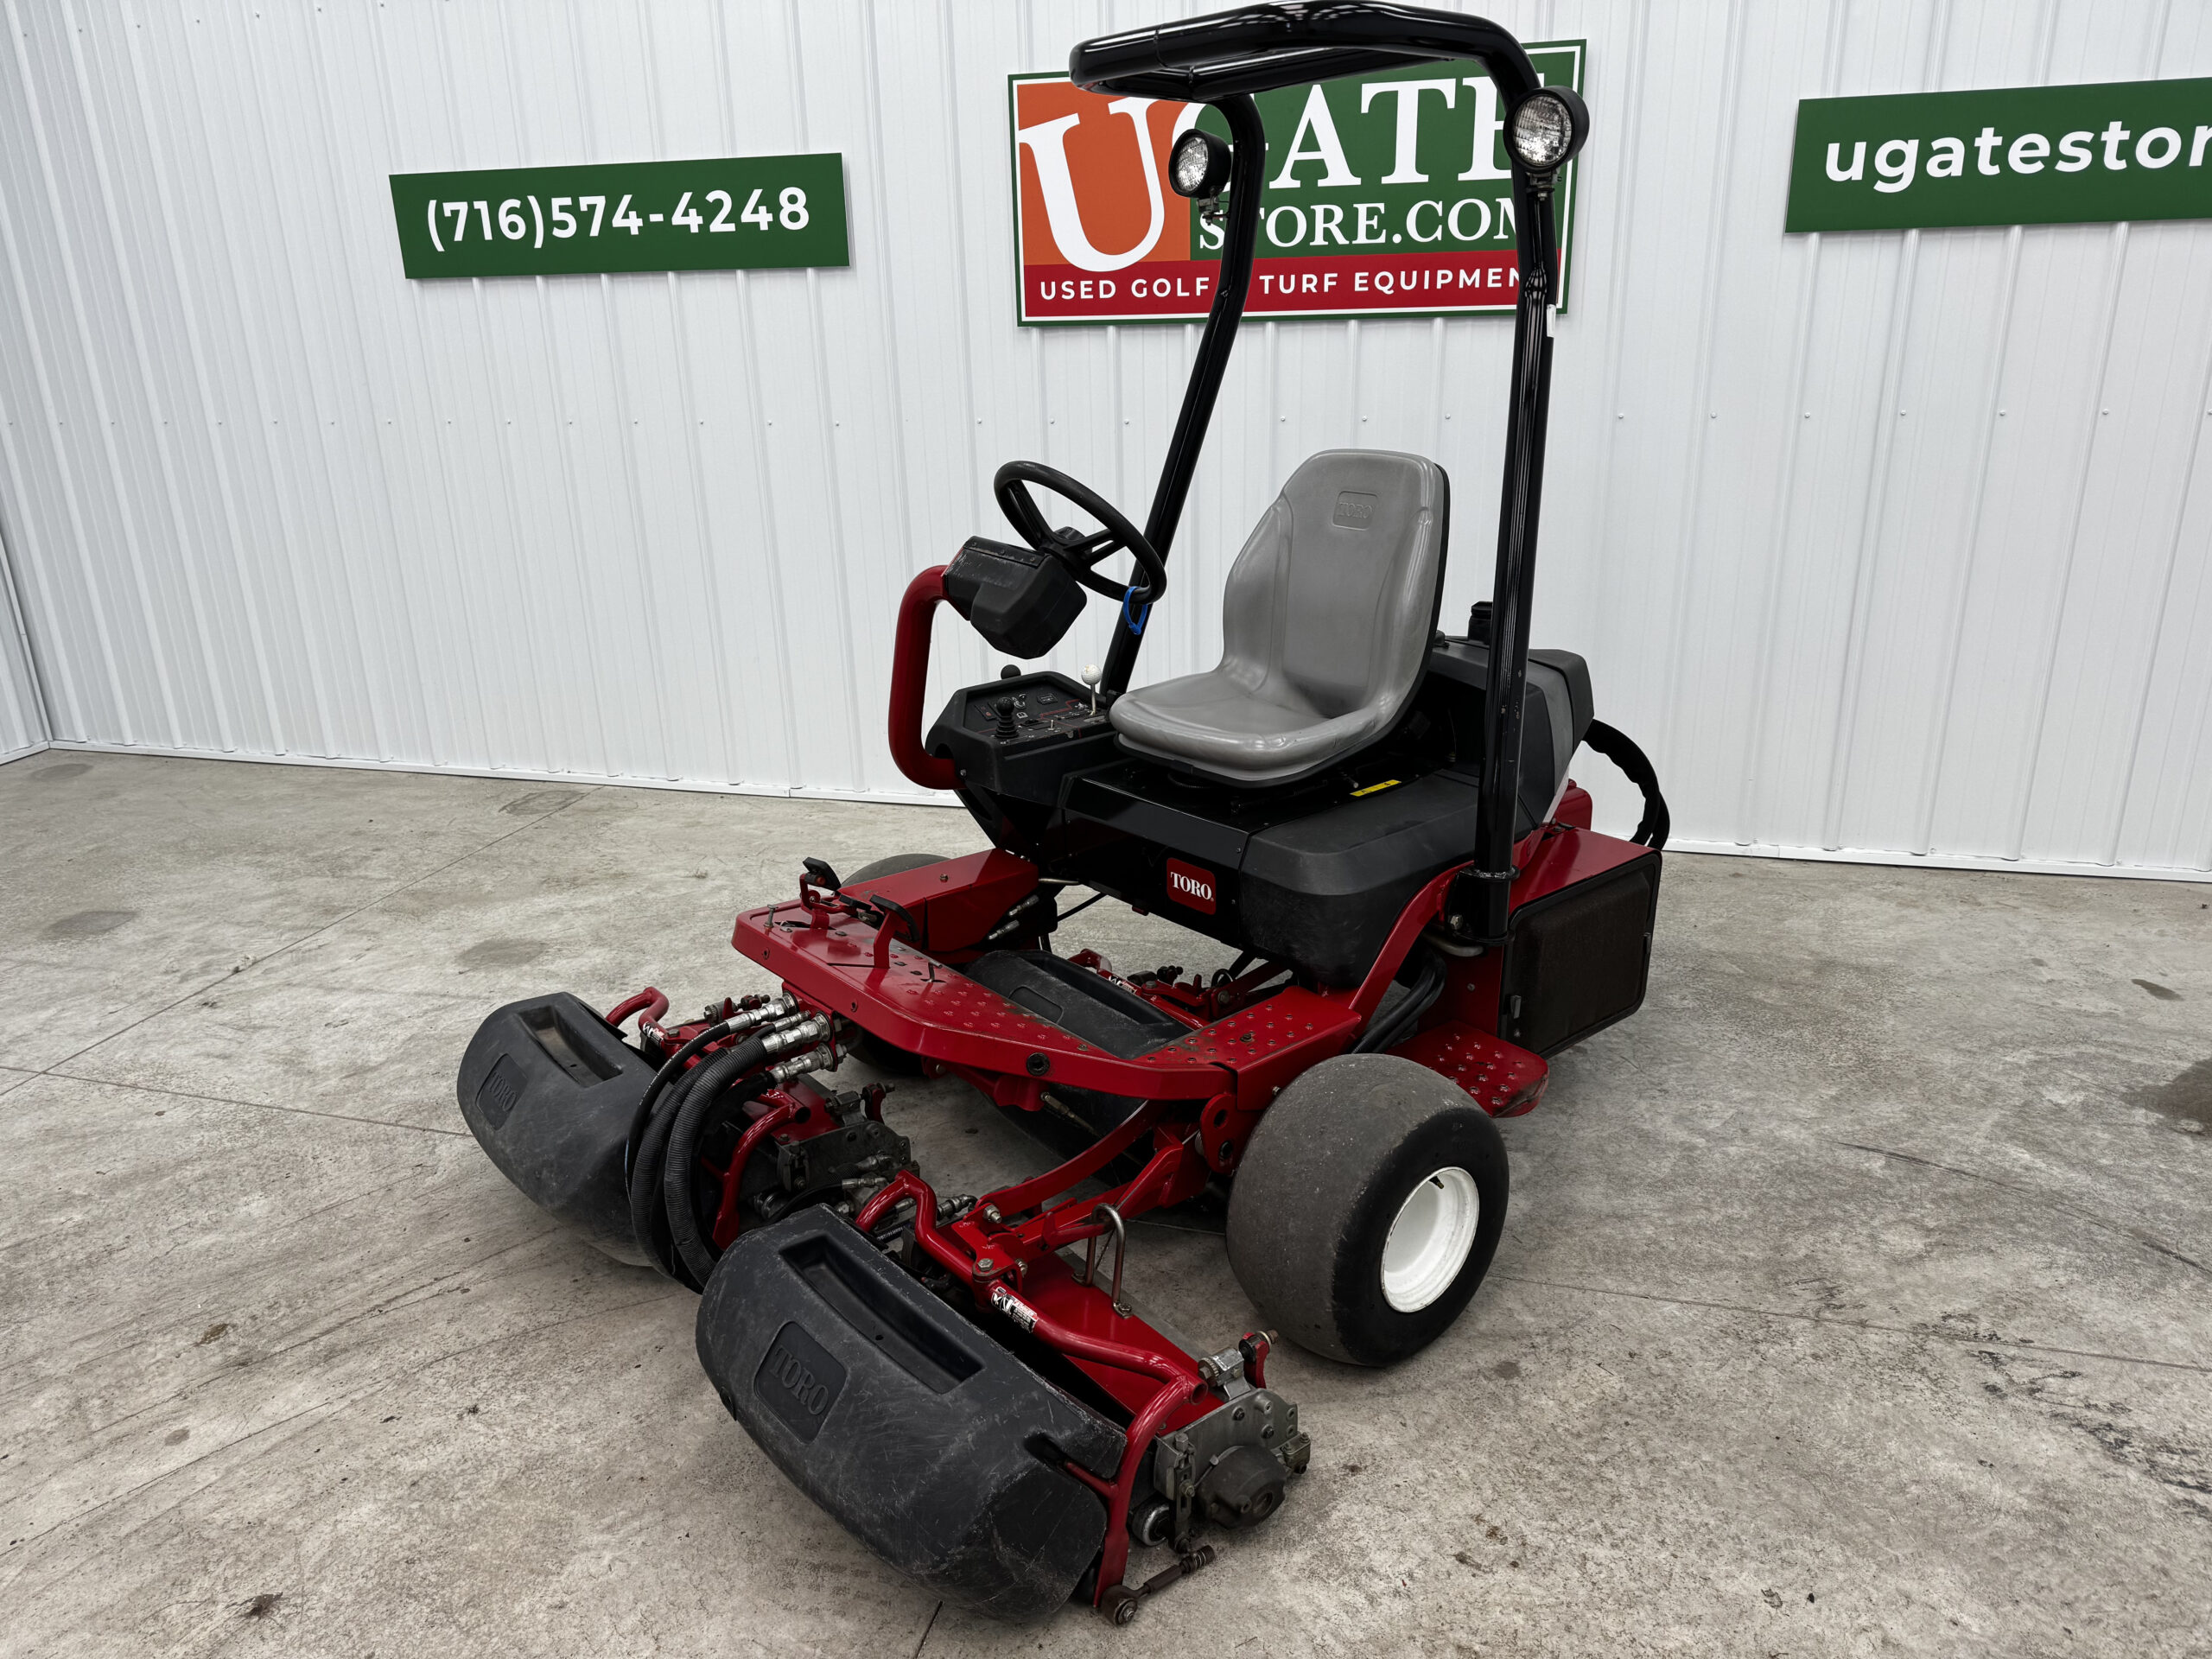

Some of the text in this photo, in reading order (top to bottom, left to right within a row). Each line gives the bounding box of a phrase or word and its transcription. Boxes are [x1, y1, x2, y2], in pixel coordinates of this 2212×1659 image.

[1016, 74, 1545, 272] UATE
[1826, 121, 2212, 193] ugatestor
[427, 187, 810, 251] (716)574-4248
[1199, 197, 1516, 250] SORE.CO
[1040, 267, 1519, 300] USED GOLF TURF EQUIPMEN
[1338, 502, 1373, 518] TORO
[1170, 871, 1212, 900] TORO
[489, 1071, 518, 1112] TORO
[769, 1344, 829, 1415] TORO
